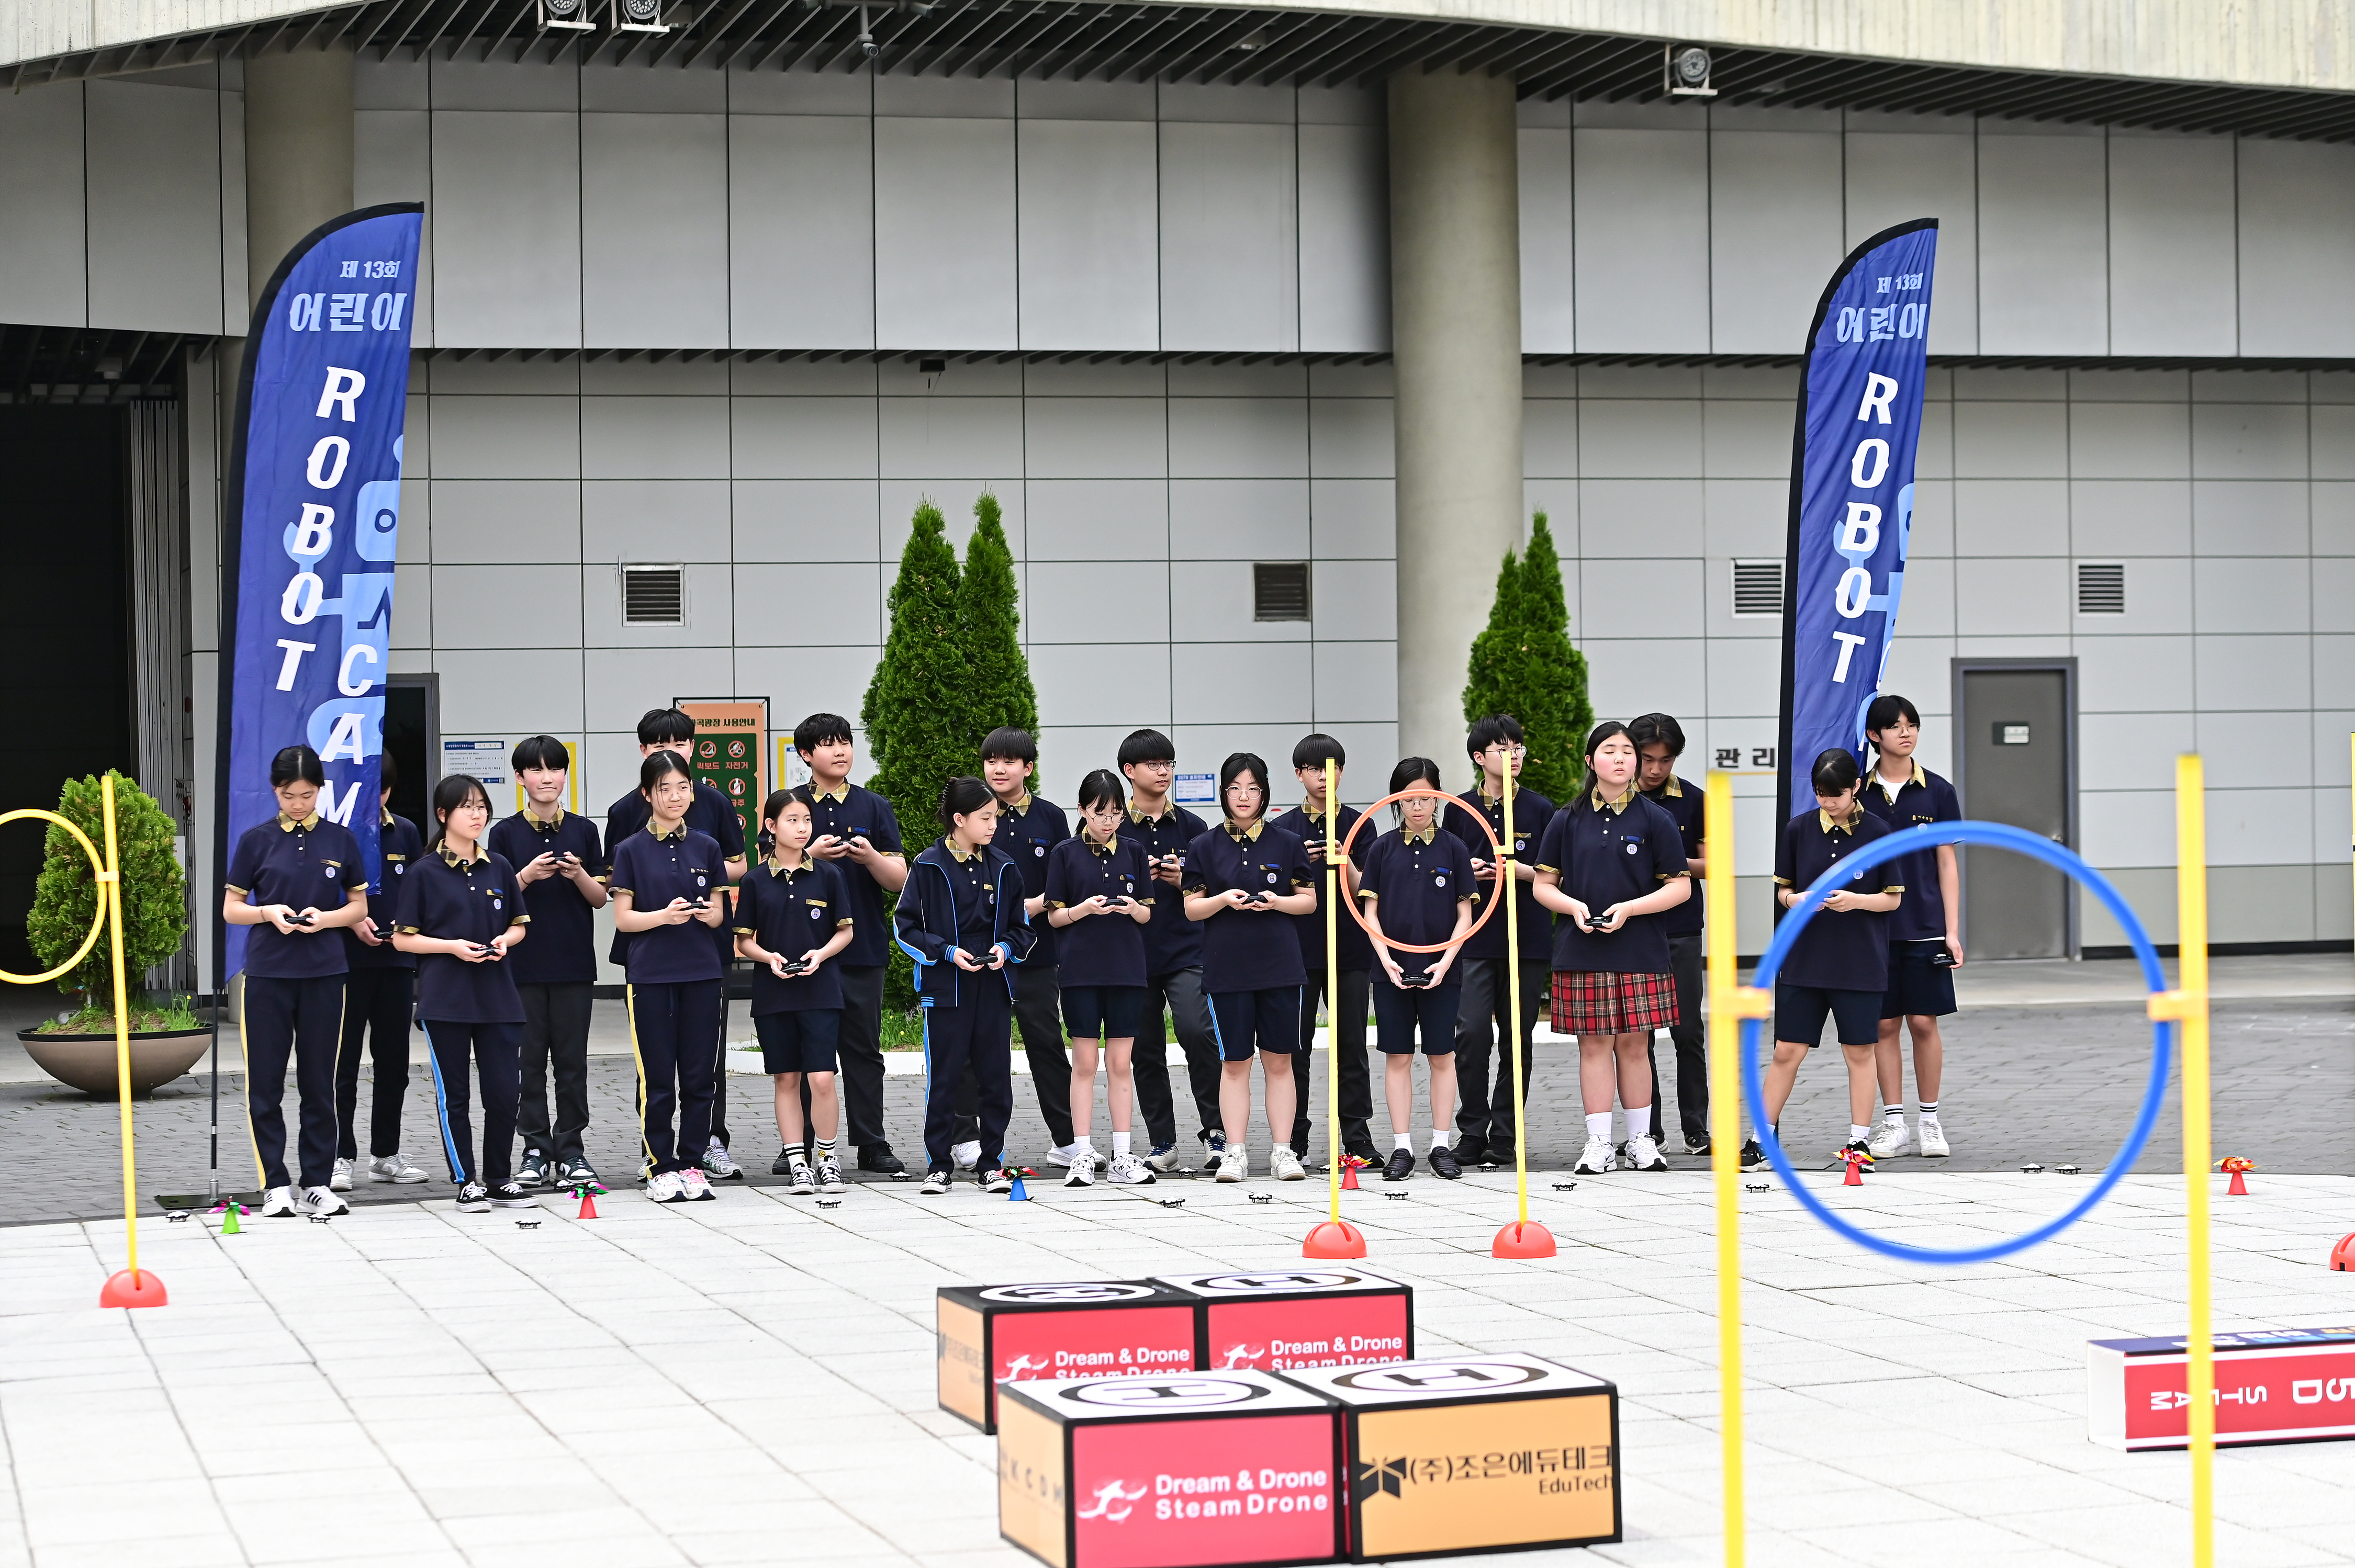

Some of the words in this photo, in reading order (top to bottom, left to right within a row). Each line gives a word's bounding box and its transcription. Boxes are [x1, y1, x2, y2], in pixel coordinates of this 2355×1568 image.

[340, 261, 358, 278] 제
[363, 261, 401, 278] 13회
[1877, 277, 1892, 293] 제
[1896, 273, 1924, 291] 13회
[289, 292, 408, 332] 어린이
[1836, 302, 1927, 343] 어린이
[275, 366, 366, 691] ROBOT
[1832, 372, 1899, 683] ROBOT
[314, 644, 378, 828] CAM
[723, 718, 755, 727] 사용안내
[1055, 1350, 1114, 1367] Dream
[1118, 1348, 1133, 1364] &
[1137, 1347, 1190, 1363] Drone
[1271, 1339, 1329, 1356] Dream
[1333, 1336, 1347, 1352] &
[1351, 1335, 1403, 1351] Drone
[1410, 1445, 1612, 1485] (주)조은에듀테크
[1156, 1474, 1231, 1496] Dream
[1236, 1469, 1254, 1491] &
[1259, 1468, 1328, 1490] Drone
[1156, 1498, 1242, 1520] Steam
[1247, 1493, 1328, 1515] Drone
